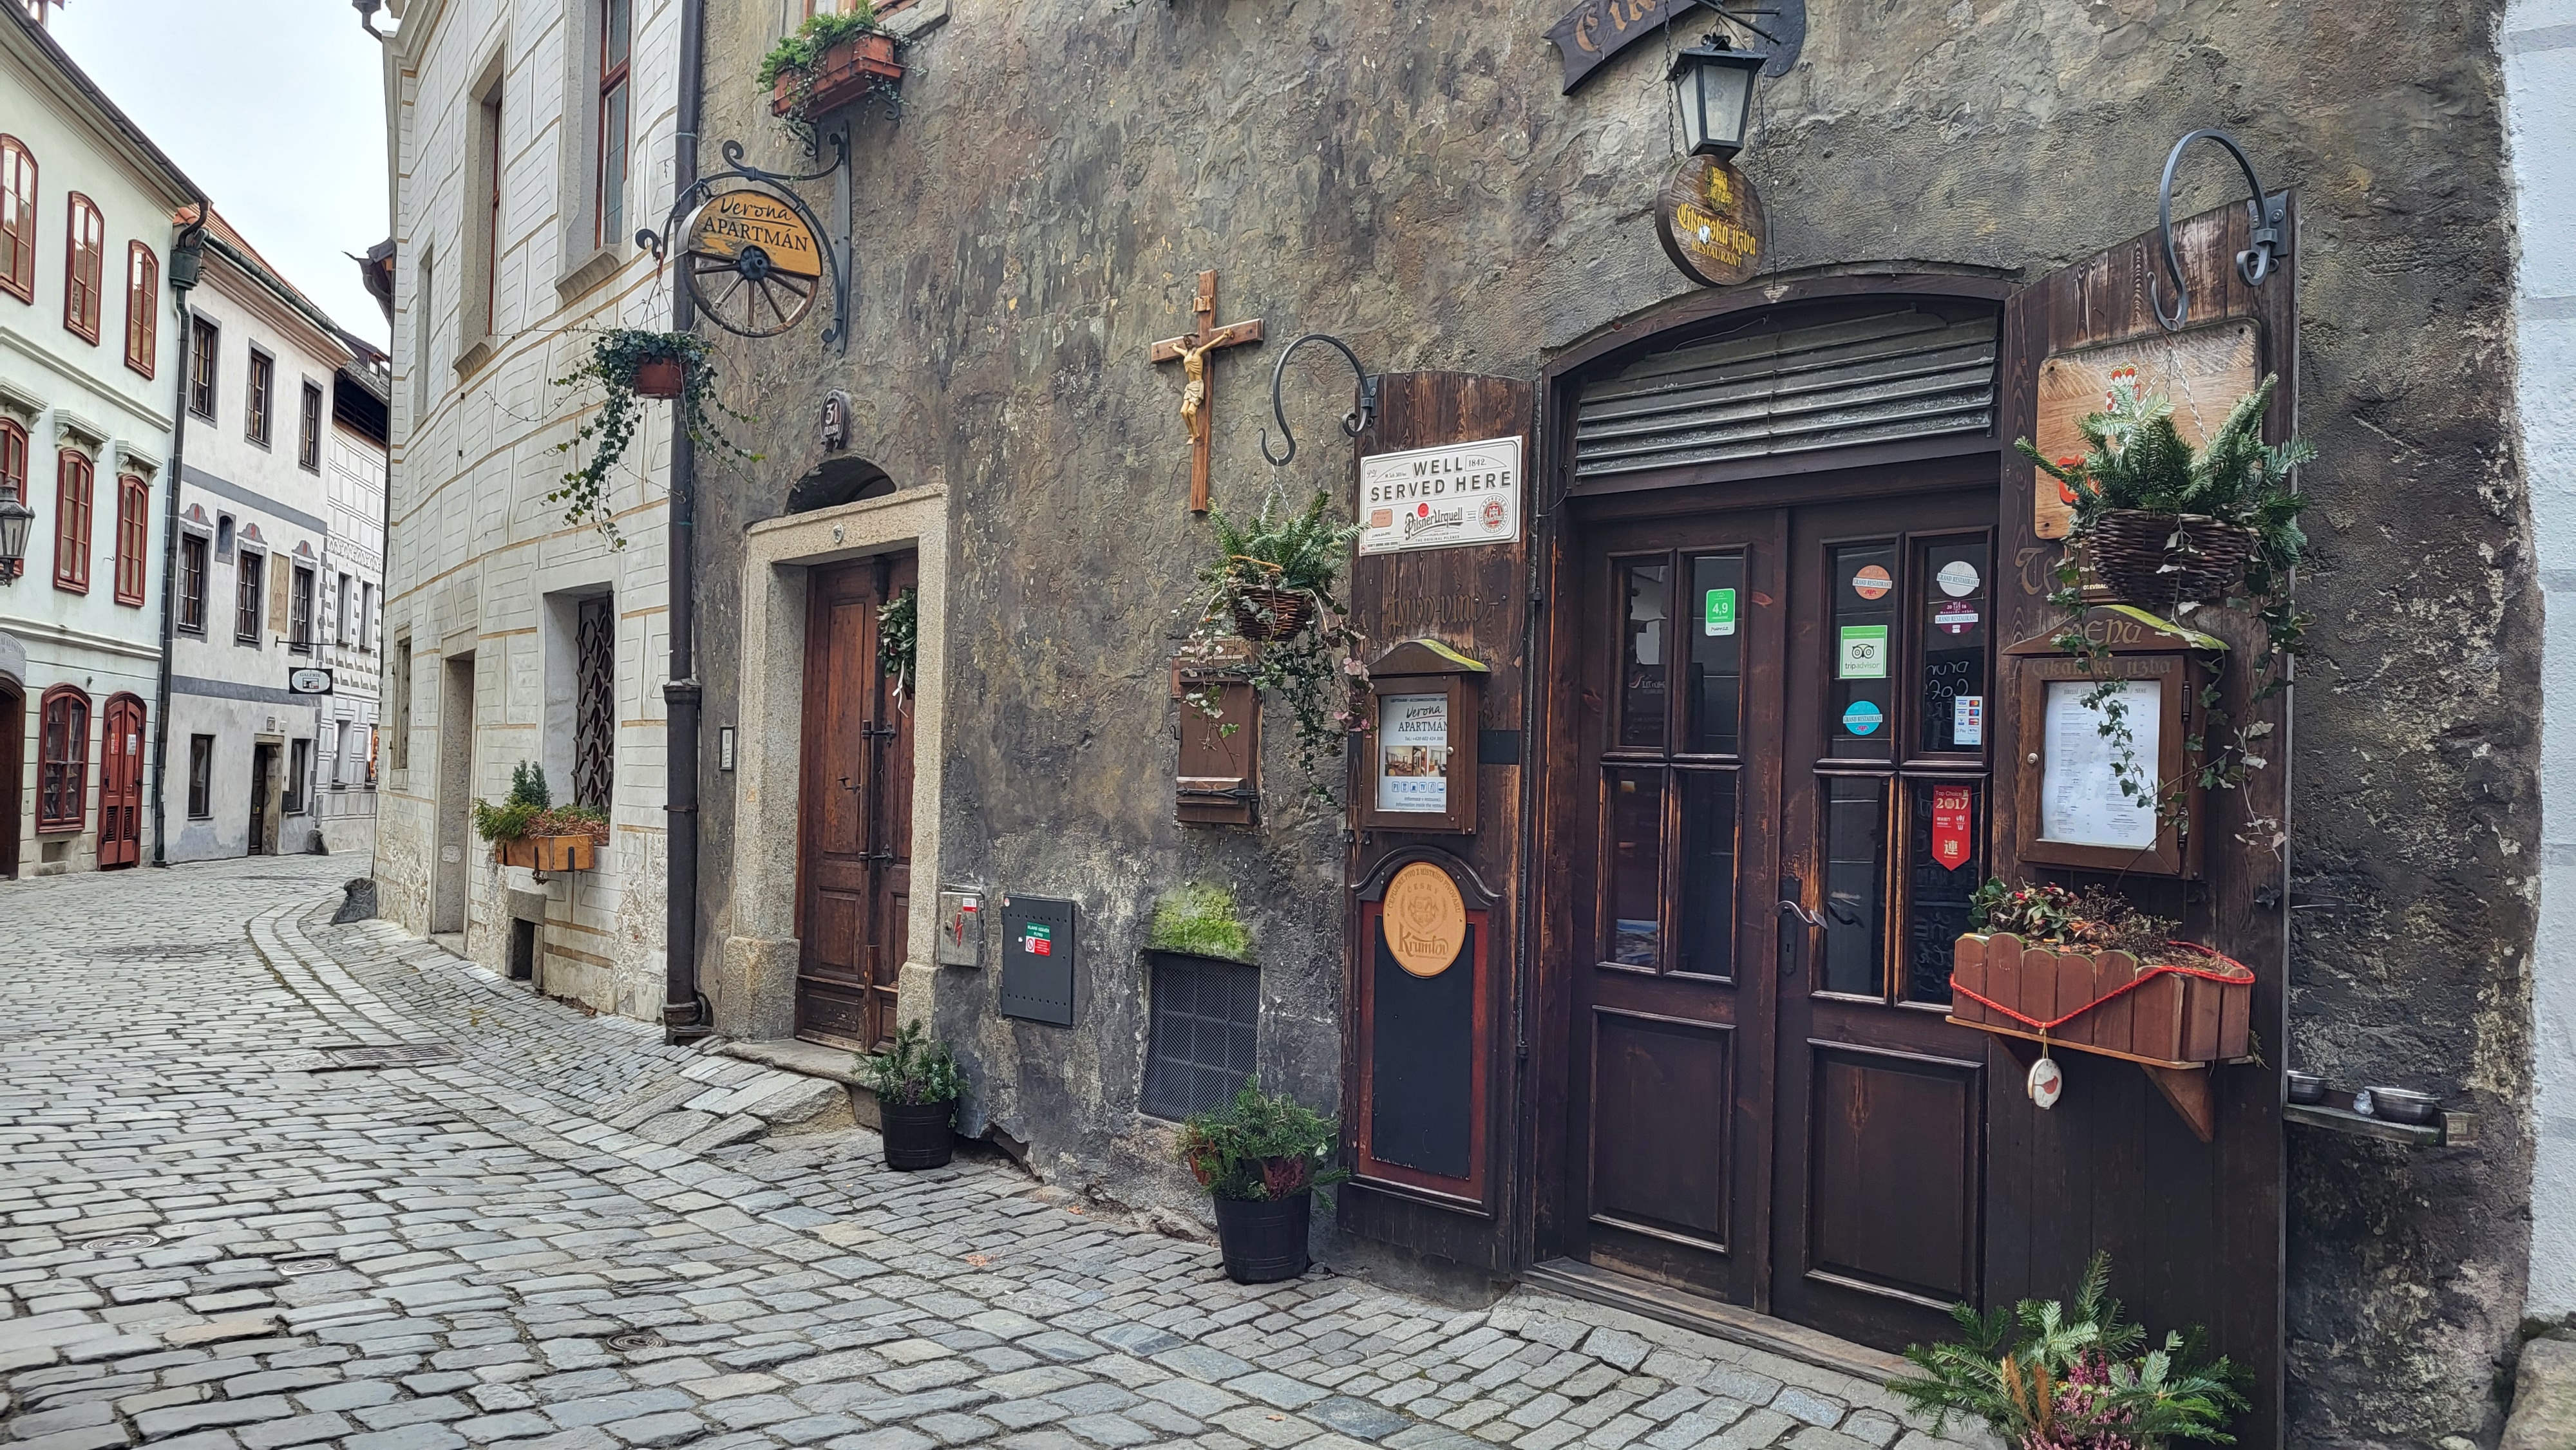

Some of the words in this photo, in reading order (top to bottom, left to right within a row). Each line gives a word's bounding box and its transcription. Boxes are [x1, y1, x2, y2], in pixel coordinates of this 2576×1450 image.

[720, 197, 793, 221] Verona
[702, 216, 808, 252] APARTMÁN
[1692, 239, 1743, 268] RESTAURANT
[825, 402, 838, 425] 31
[1412, 457, 1463, 478] WELL
[1370, 479, 1445, 502] SERVED
[1455, 471, 1511, 493] HERE
[1482, 497, 1506, 508] APPROVED
[1405, 512, 1434, 540] Pilsner
[1434, 507, 1463, 528] Urquell
[1953, 577, 1979, 586] RESTAURANT
[1712, 602, 1728, 616] 4,9
[1845, 662, 1880, 670] tripadvisor
[1406, 706, 1443, 719] Verona
[1936, 796, 1969, 810] 2017
[1405, 869, 1416, 880] PIVO
[1443, 880, 1461, 913] PIVOVARU
[1407, 883, 1439, 894] ČESKÝ
[1398, 921, 1448, 957] Krumlov
